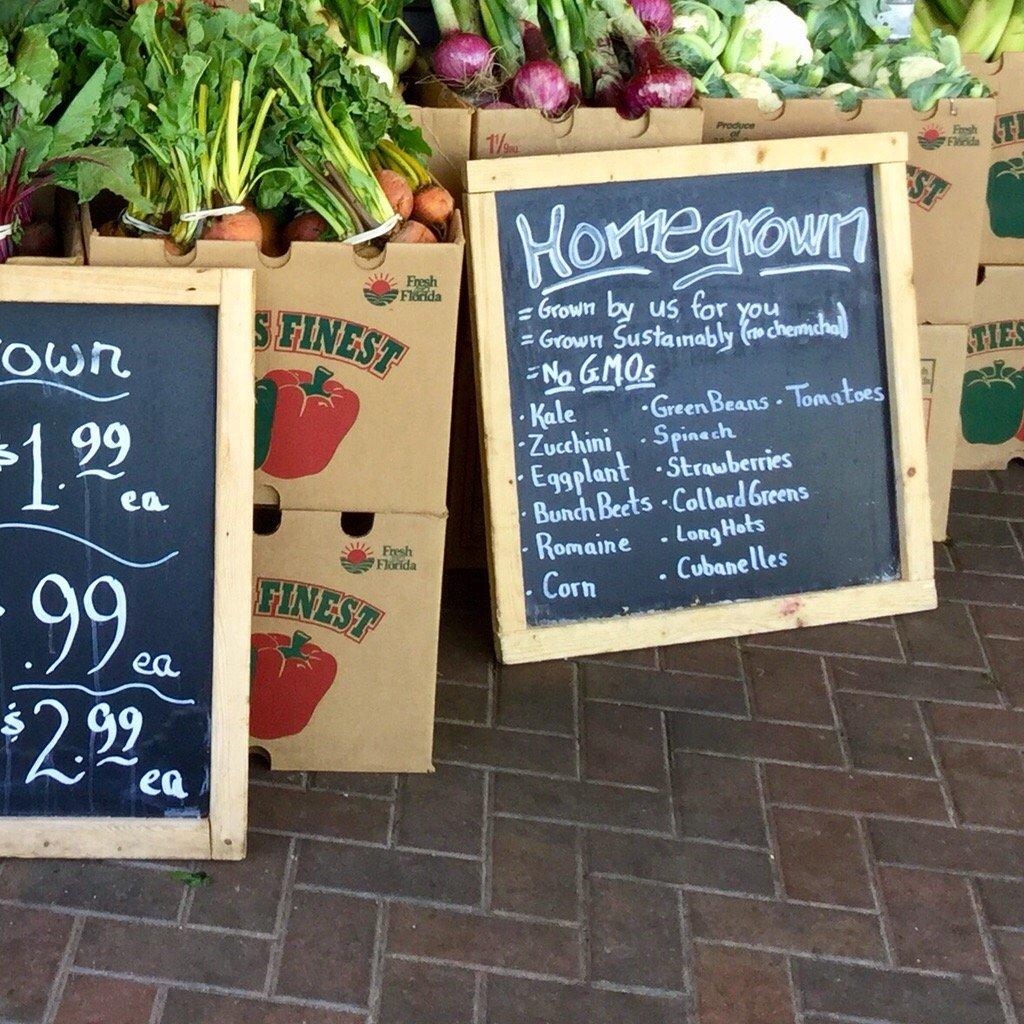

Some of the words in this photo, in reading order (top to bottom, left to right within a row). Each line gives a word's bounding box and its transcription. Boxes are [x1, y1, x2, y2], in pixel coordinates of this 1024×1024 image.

[516, 204, 869, 290] Homegrown
[406, 274, 437, 287] Fresh
[400, 290, 442, 302] Florida
[538, 297, 596, 319] Grown
[607, 290, 635, 323] by
[649, 299, 679, 319] us
[690, 290, 728, 320] for
[737, 302, 780, 326] you
[277, 312, 407, 377] FINEST
[539, 329, 604, 350] Grown
[613, 322, 734, 354] Sustainably
[542, 360, 572, 386] No
[530, 399, 577, 430] Kale
[785, 378, 885, 408] Tomatoes
[528, 428, 612, 456] Zucchini
[531, 451, 630, 496] Eggplant
[667, 449, 793, 477] Strawberries
[121, 489, 169, 511] ea
[382, 545, 413, 557] Fresh
[536, 532, 632, 560] Romaine
[377, 559, 417, 571] Florida
[543, 571, 596, 599] Corn
[677, 545, 788, 579] Cubanelles
[256, 579, 384, 641] FINEST
[133, 651, 181, 678] ea
[139, 770, 188, 799] ea
